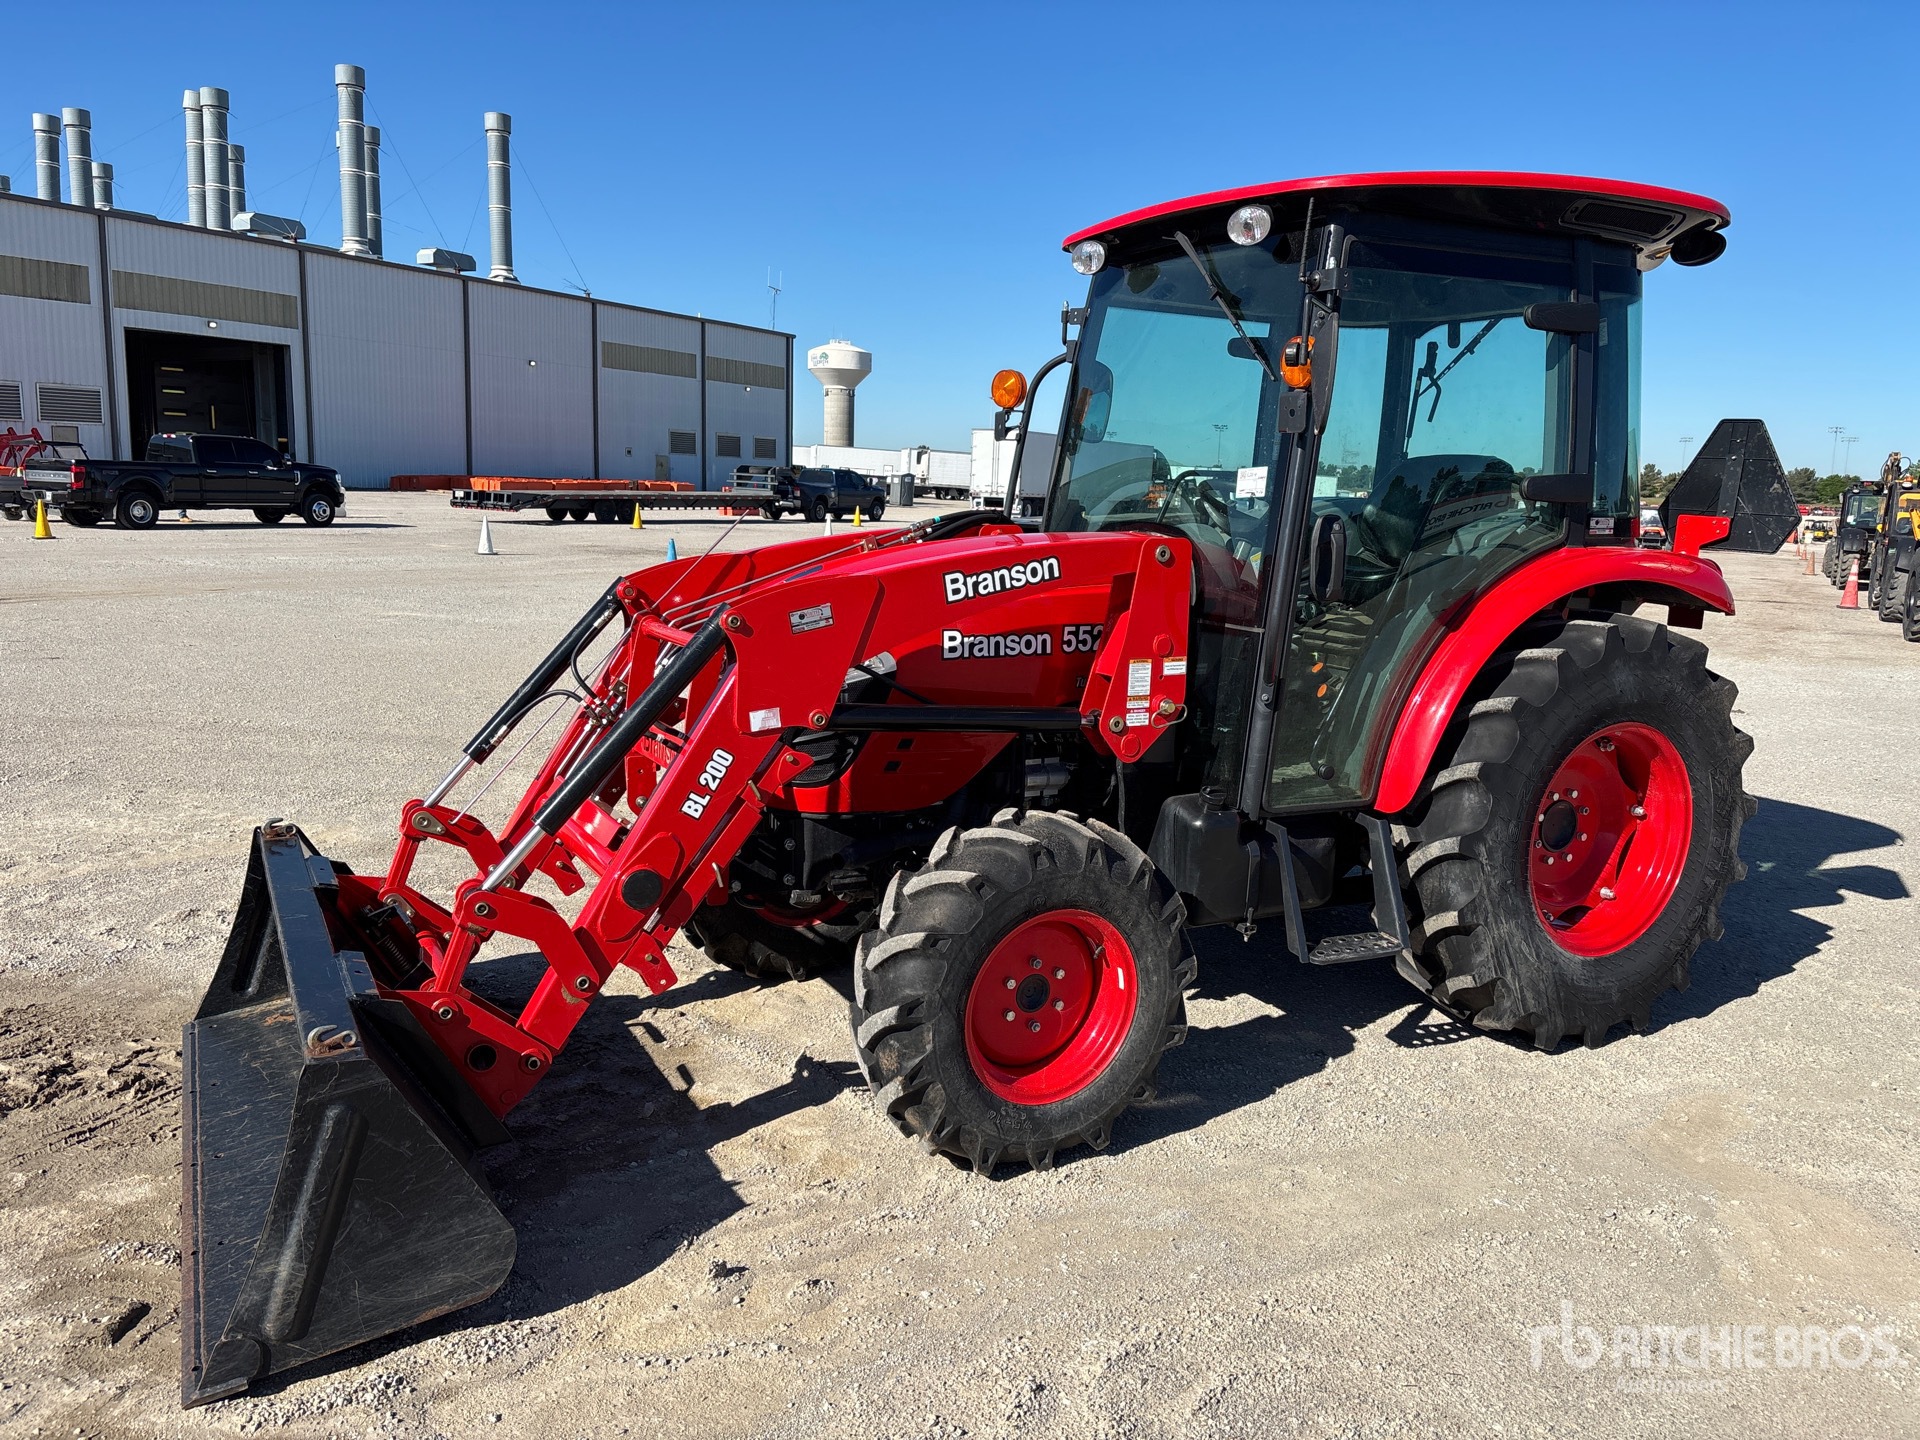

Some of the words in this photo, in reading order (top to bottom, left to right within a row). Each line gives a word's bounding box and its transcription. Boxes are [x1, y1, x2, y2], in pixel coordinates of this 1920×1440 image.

[944, 557, 1060, 602] Branson
[943, 630, 1052, 659] Branson
[681, 792, 711, 819] BL
[699, 749, 733, 791] 200
